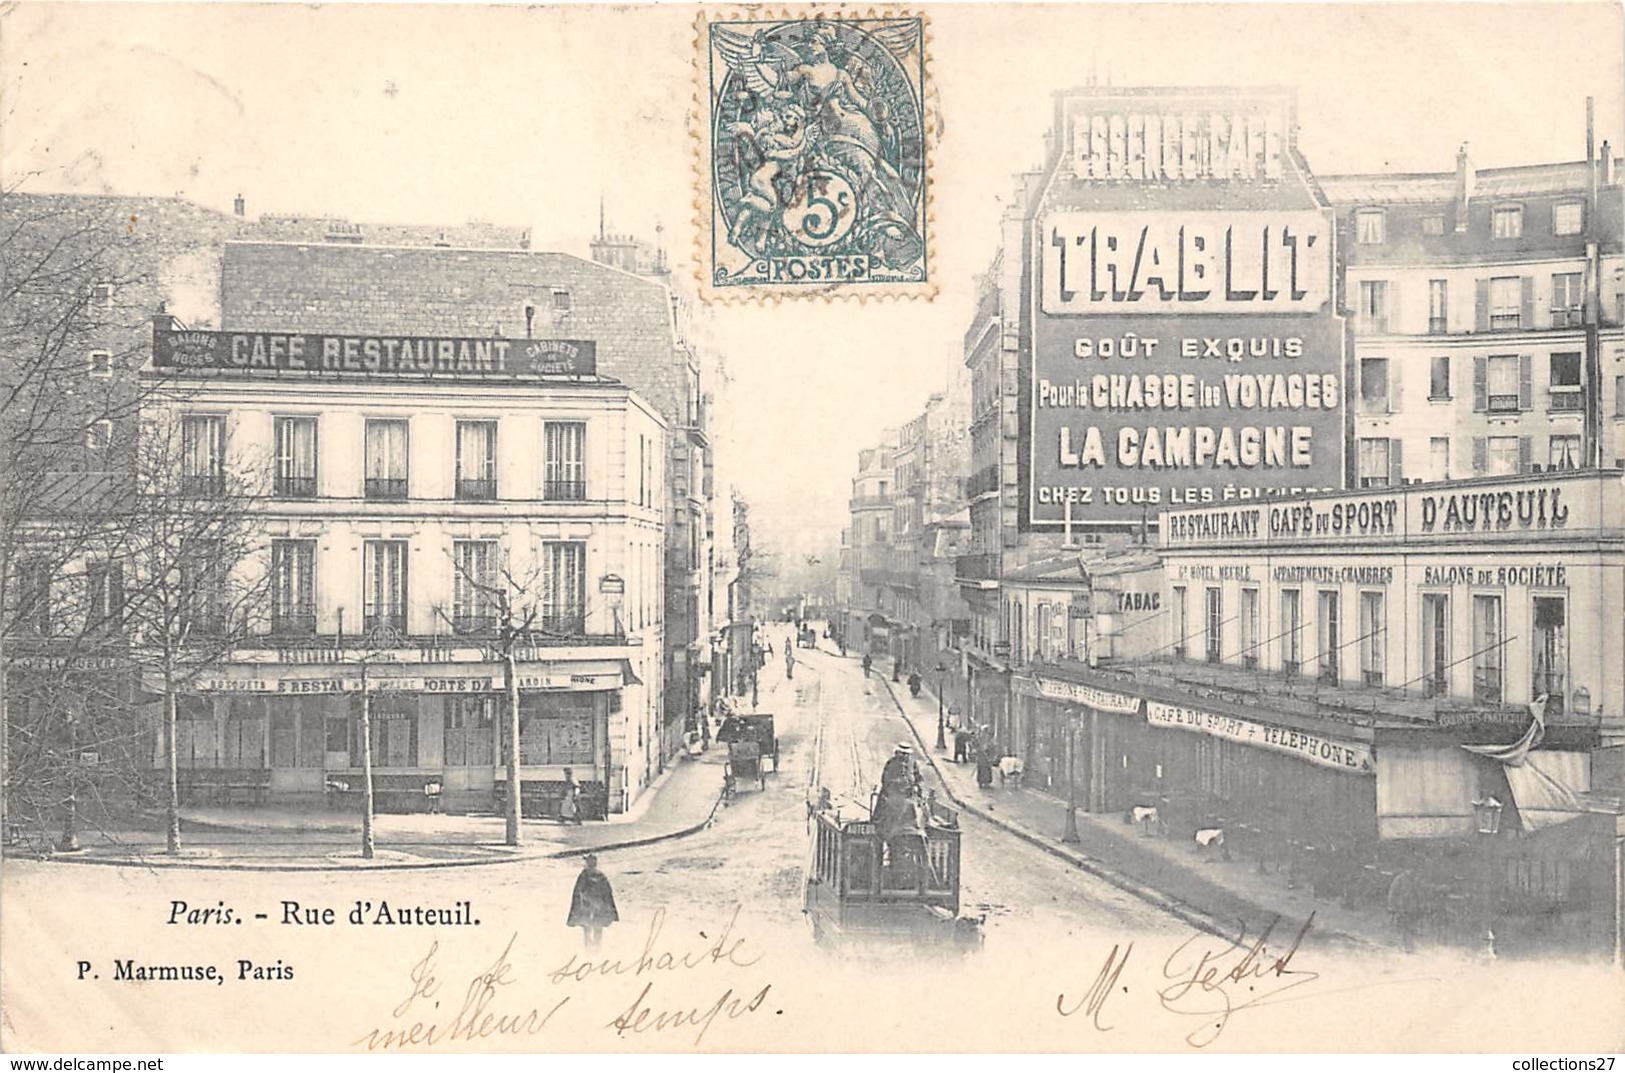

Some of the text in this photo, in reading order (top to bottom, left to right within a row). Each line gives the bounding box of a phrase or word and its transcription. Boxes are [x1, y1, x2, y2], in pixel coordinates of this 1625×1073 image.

[772, 257, 867, 281] POSTES
[1052, 223, 1317, 302] TRABLIT
[322, 337, 511, 372] RESTAURANT
[526, 341, 579, 359] CABINETS
[1074, 332, 1304, 362] GOÛT EXQUIS
[1038, 378, 1073, 408] Pour
[1091, 374, 1196, 409] CHASSE
[1223, 374, 1340, 410] VOYAGES
[1058, 426, 1313, 469] LA CAMPAGNE
[1039, 486, 1093, 504] CHEZ
[1103, 487, 1161, 504] TOUS
[1170, 487, 1214, 504] LES
[1171, 486, 1569, 539] RESTAURANT CAFÉ DU SPORT D'AUTEUIL
[1273, 566, 1334, 583] APPARTEMENTS
[1341, 566, 1394, 584] CHAMBRES
[1424, 561, 1566, 586] SALONS DE SOCIÉTÉ
[1116, 592, 1161, 612] TABAC
[1207, 713, 1243, 738] SPORT
[166, 900, 243, 926] Paris.
[280, 900, 336, 926] Rue
[349, 900, 482, 926] d'Auteuil.
[550, 904, 762, 985] souhaite
[76, 960, 295, 985] P. Marmuse, Paris
[356, 975, 785, 1051] meilleur temps.
